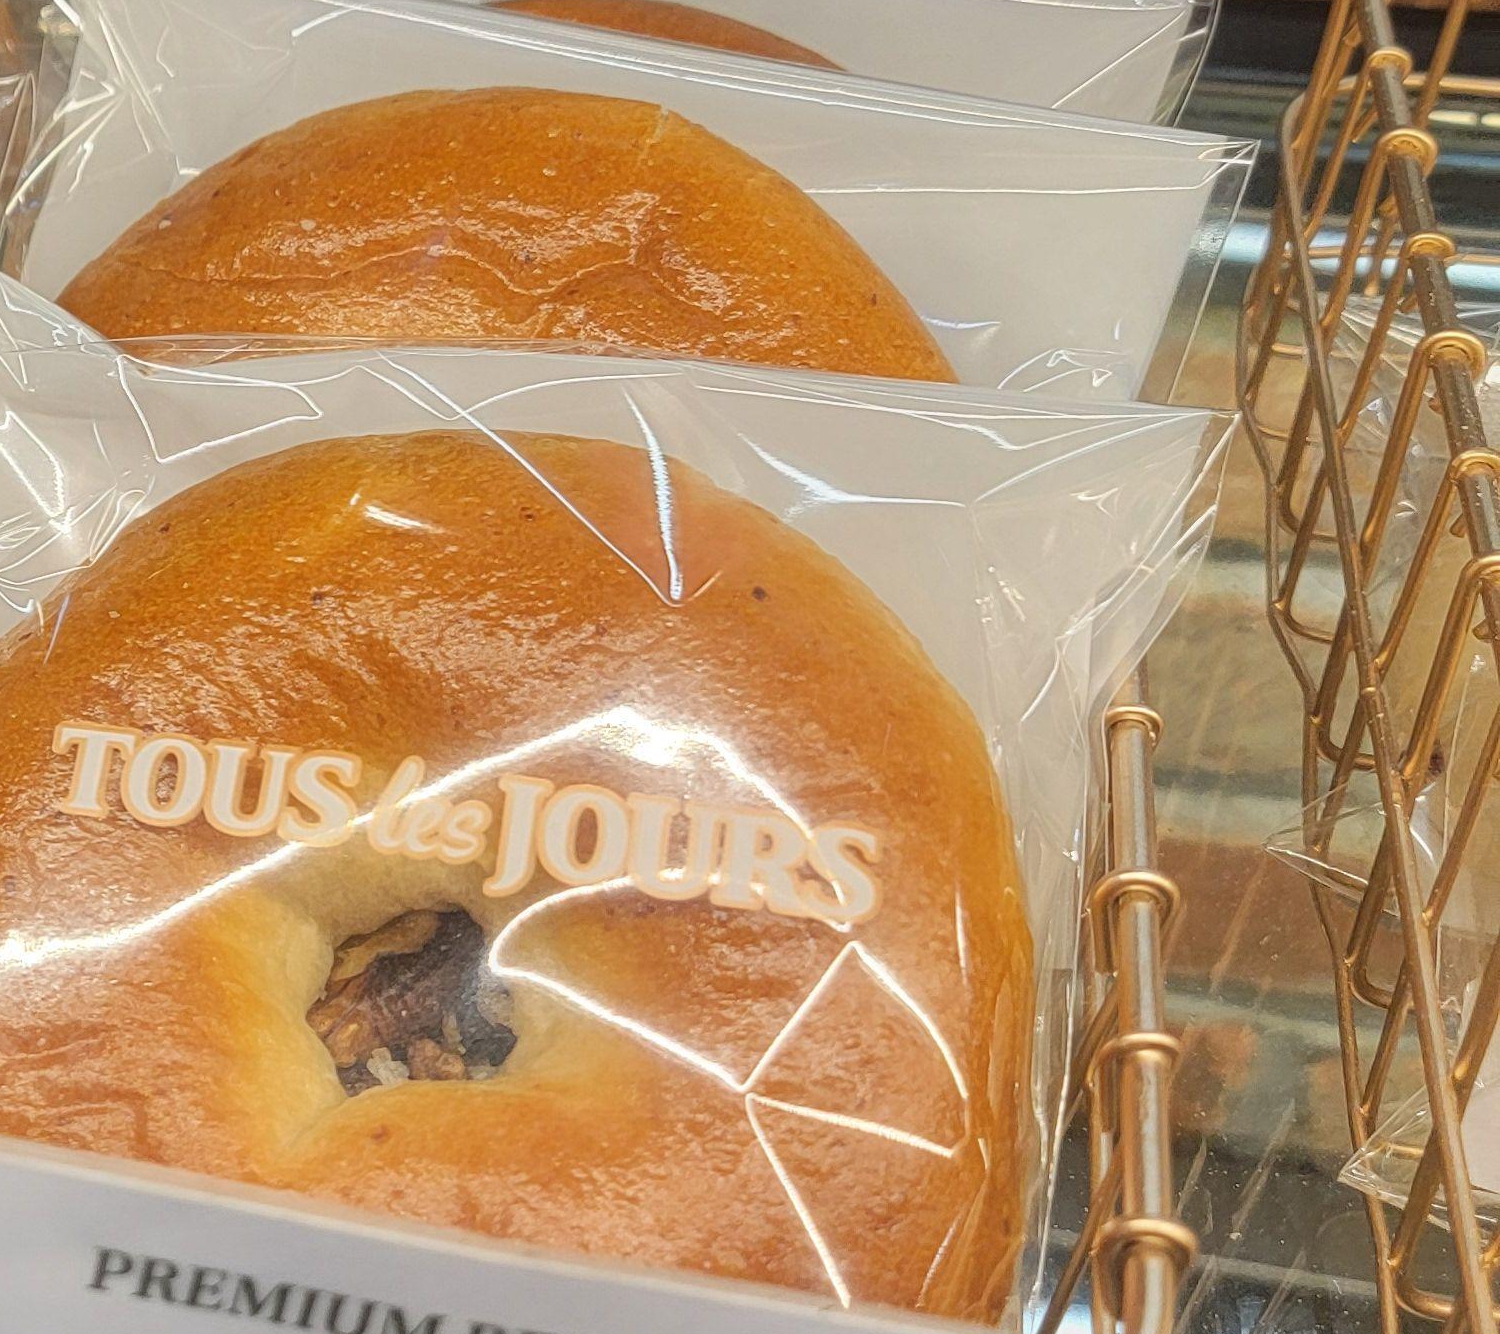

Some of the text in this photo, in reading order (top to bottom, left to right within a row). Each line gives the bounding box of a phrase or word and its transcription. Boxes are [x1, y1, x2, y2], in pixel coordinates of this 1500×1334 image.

[52, 720, 885, 924] TOUS les JOURS
